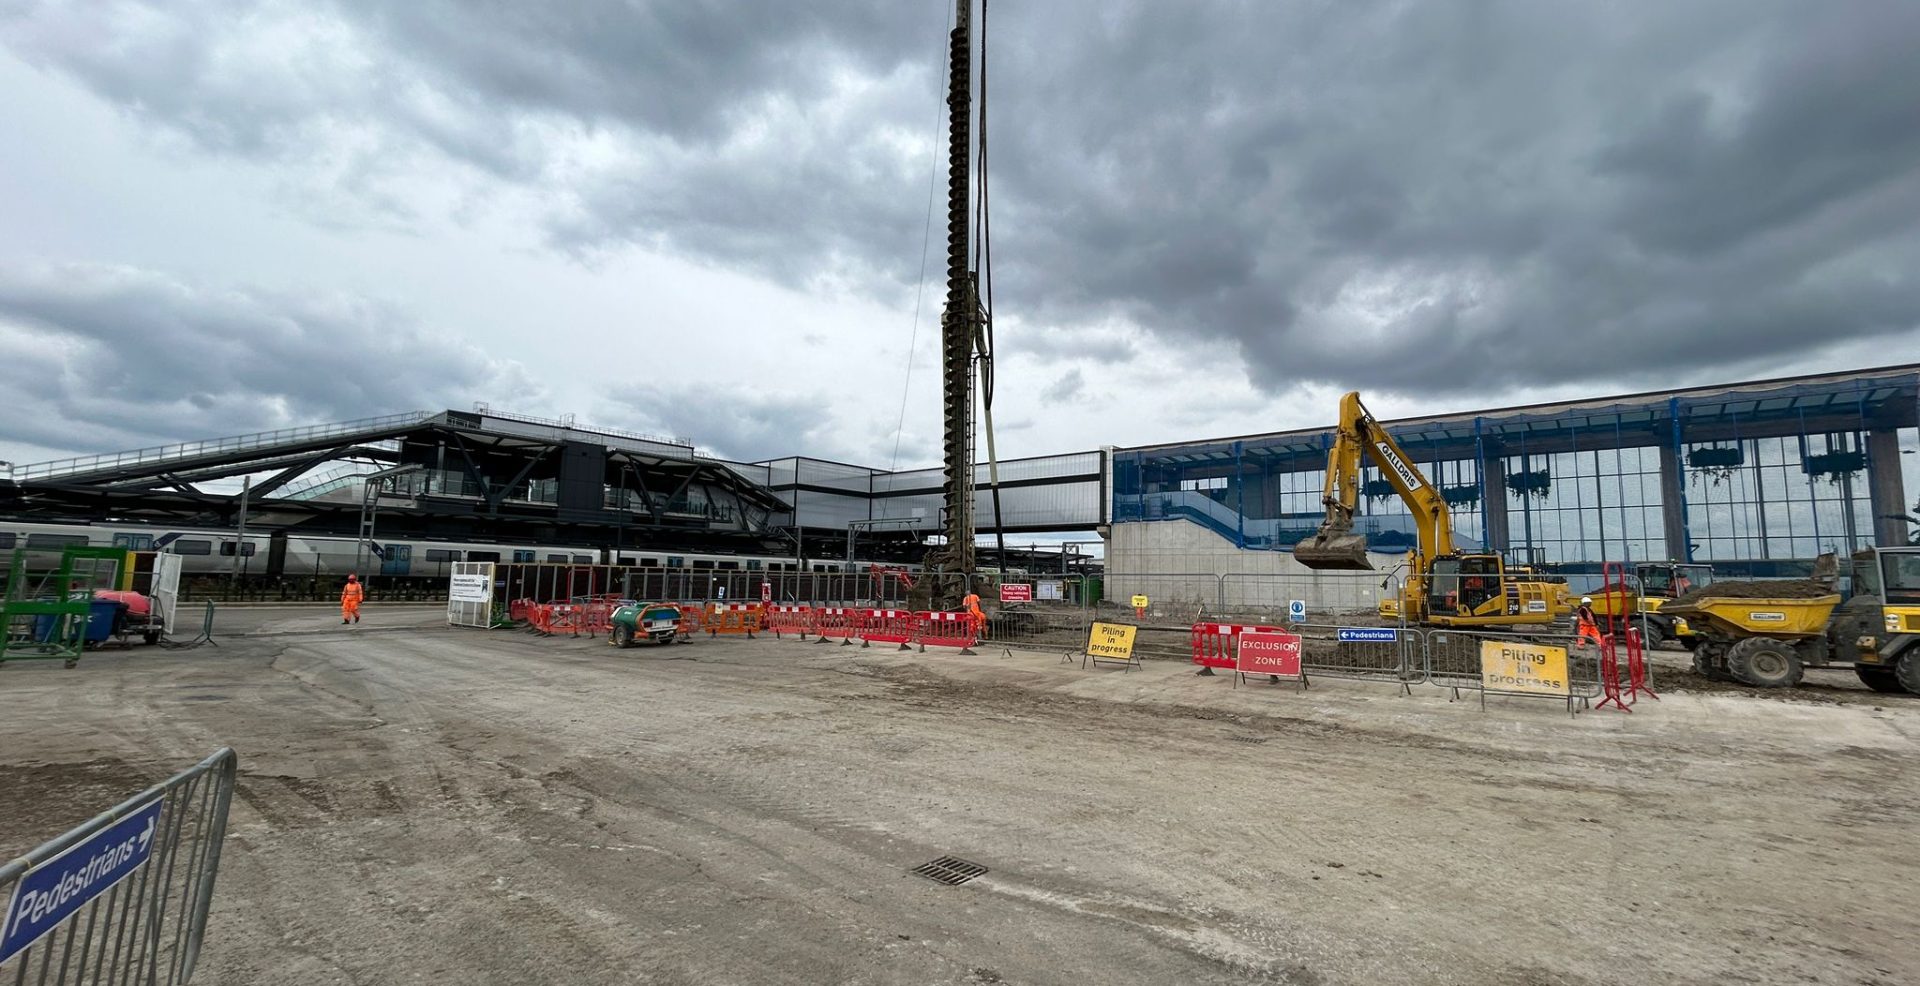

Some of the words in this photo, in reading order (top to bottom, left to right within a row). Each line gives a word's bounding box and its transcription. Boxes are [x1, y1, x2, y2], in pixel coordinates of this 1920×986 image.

[1382, 445, 1416, 487] GALLDRIS
[1102, 626, 1125, 638] Piling
[1350, 631, 1394, 640] Pedestrians
[1091, 644, 1128, 655] progress
[1242, 640, 1298, 652] EXCLUSION
[1255, 656, 1283, 667] ZONE
[1502, 648, 1546, 665] Piling
[1517, 663, 1531, 674] in
[1490, 674, 1561, 690] progress
[10, 836, 136, 938] Pedestrians
